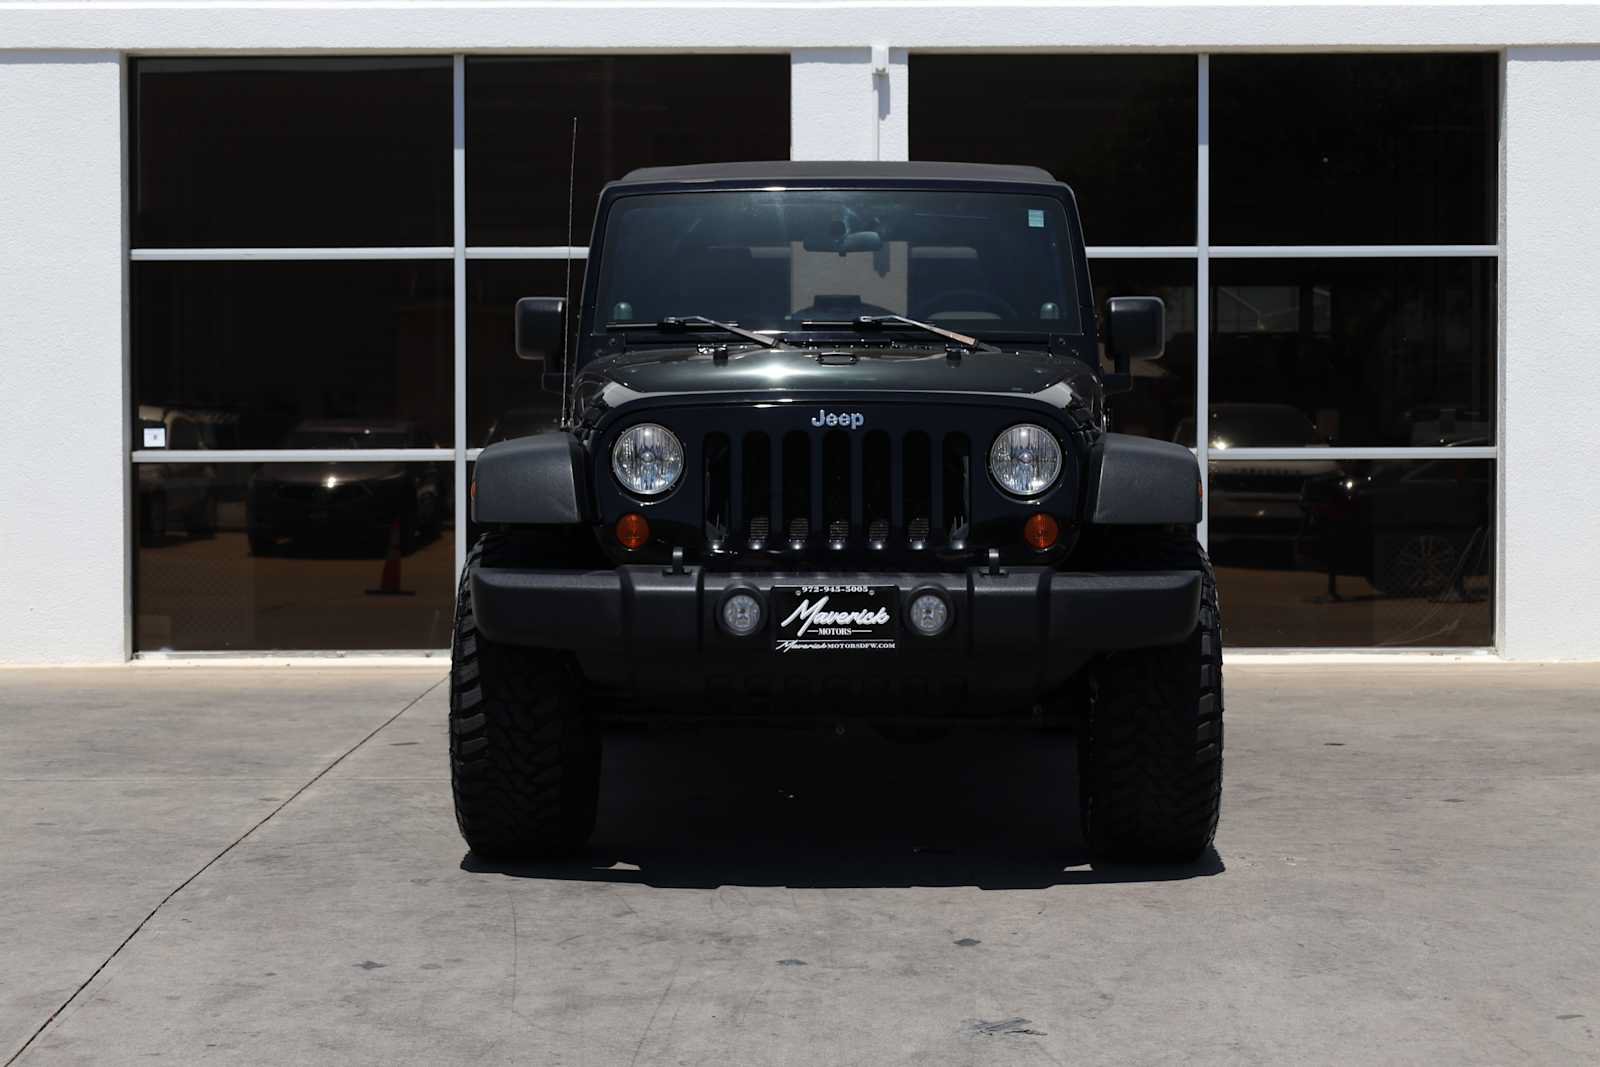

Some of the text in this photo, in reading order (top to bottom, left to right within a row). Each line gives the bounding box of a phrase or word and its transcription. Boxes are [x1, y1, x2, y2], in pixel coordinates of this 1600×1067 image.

[811, 409, 864, 430] Jeep
[780, 595, 890, 637] Maverick
[818, 628, 852, 636] MOTORS
